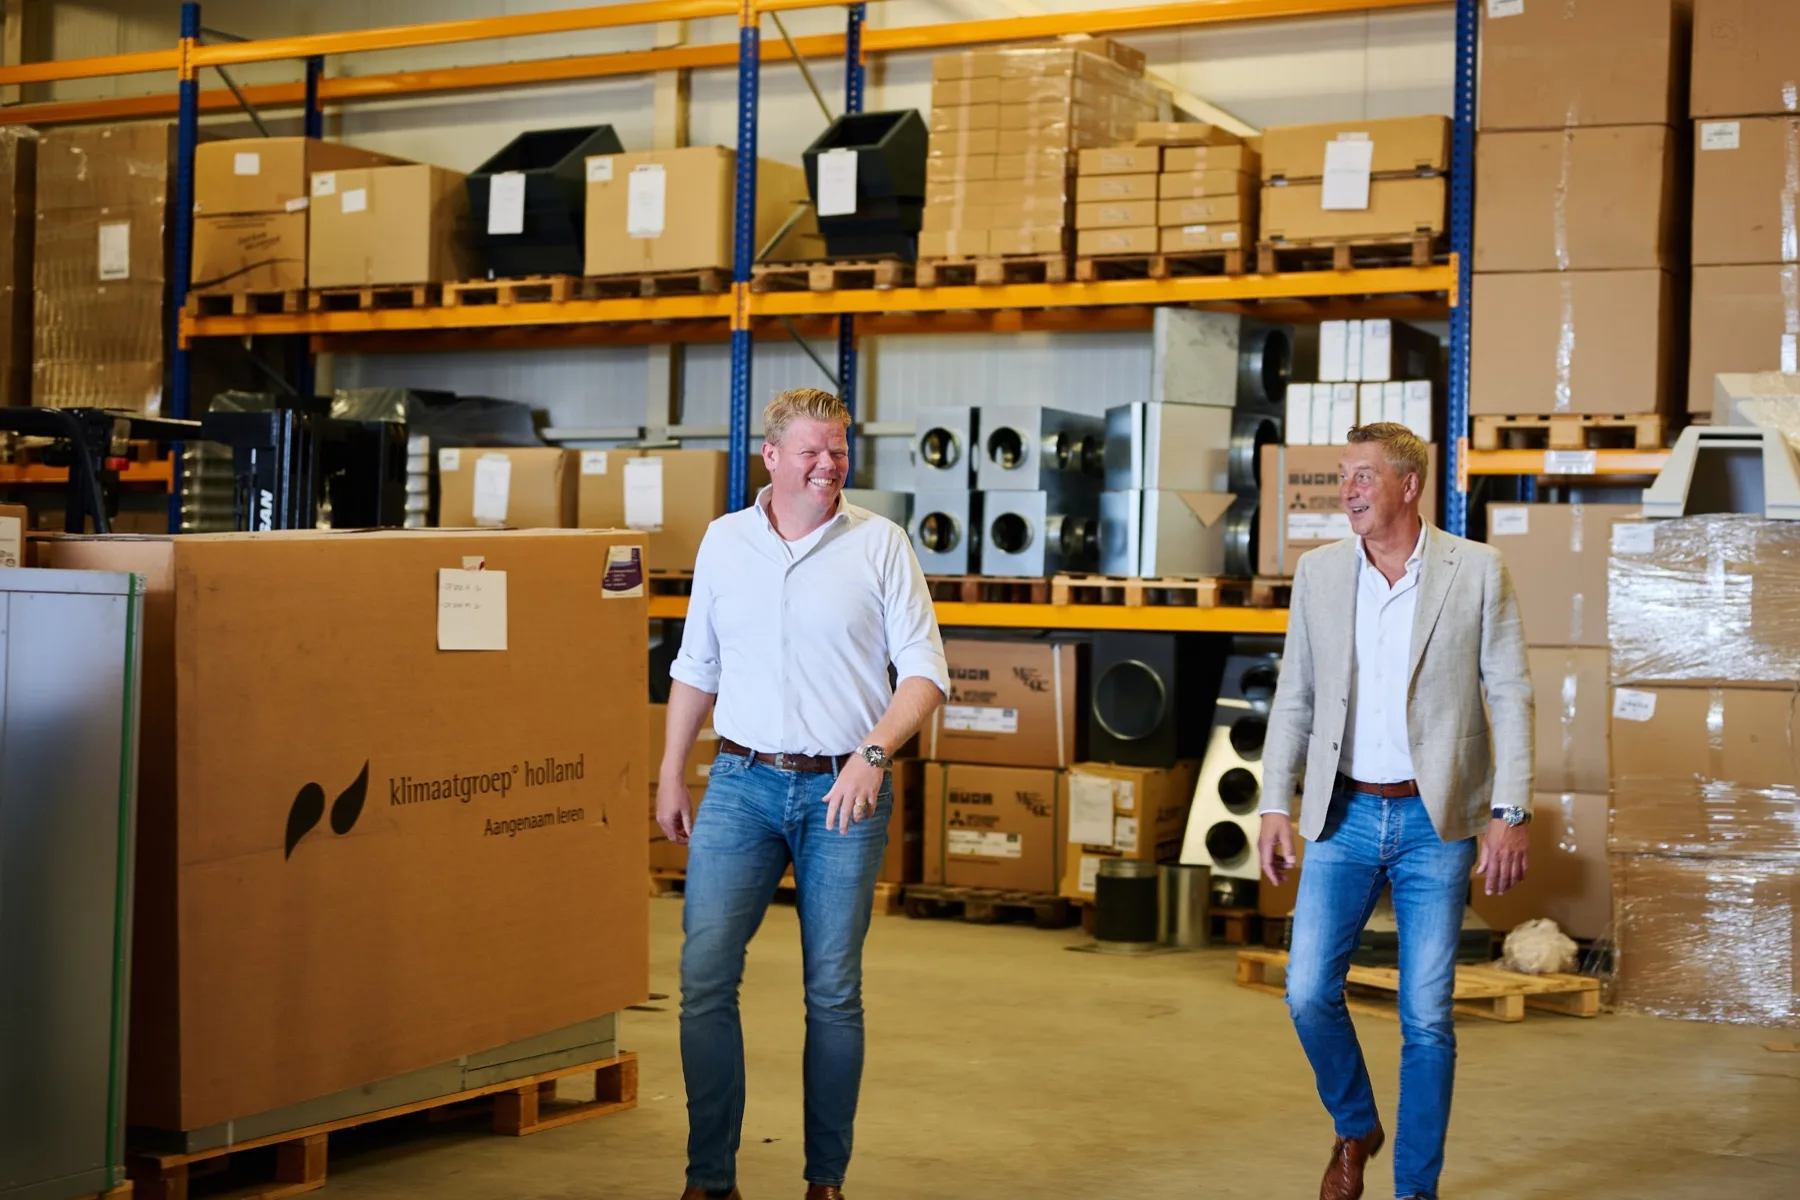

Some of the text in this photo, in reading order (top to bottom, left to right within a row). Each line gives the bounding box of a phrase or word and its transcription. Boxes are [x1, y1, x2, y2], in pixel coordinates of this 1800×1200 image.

[524, 752, 585, 788] holland
[483, 806, 585, 838] Aangenaam leren
